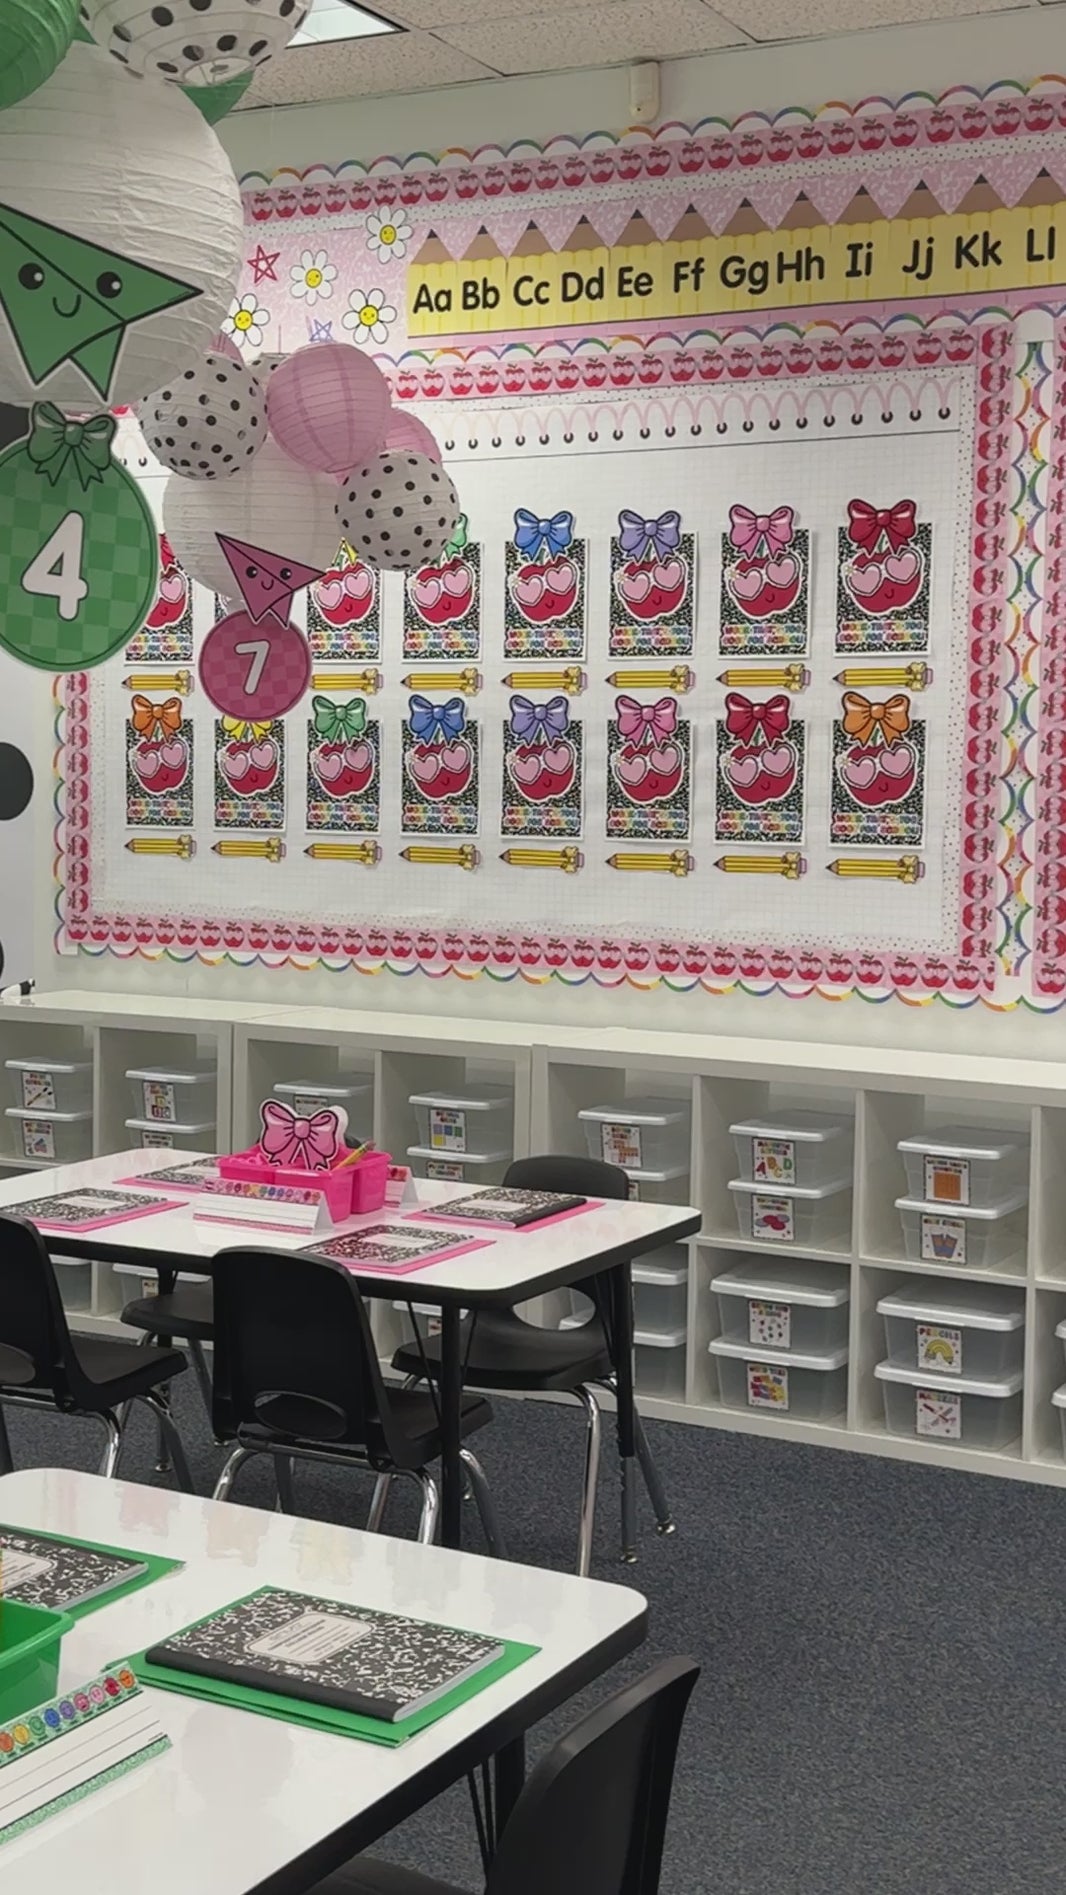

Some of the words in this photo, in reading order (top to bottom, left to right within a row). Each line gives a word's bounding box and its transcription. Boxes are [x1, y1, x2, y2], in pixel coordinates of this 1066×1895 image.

[412, 283, 452, 314] Aa
[461, 277, 500, 311] Bb
[513, 275, 551, 306] Cc
[561, 266, 605, 302] Dd
[617, 266, 653, 297] Ee
[673, 257, 705, 293] Ff
[720, 255, 769, 295] Gg
[776, 246, 825, 284] Hh
[845, 241, 873, 278] Ii
[902, 236, 934, 280] Jj
[955, 230, 1002, 269] Kk
[1026, 226, 1056, 262] Ll
[21, 510, 89, 621] 4
[235, 639, 271, 696] 7
